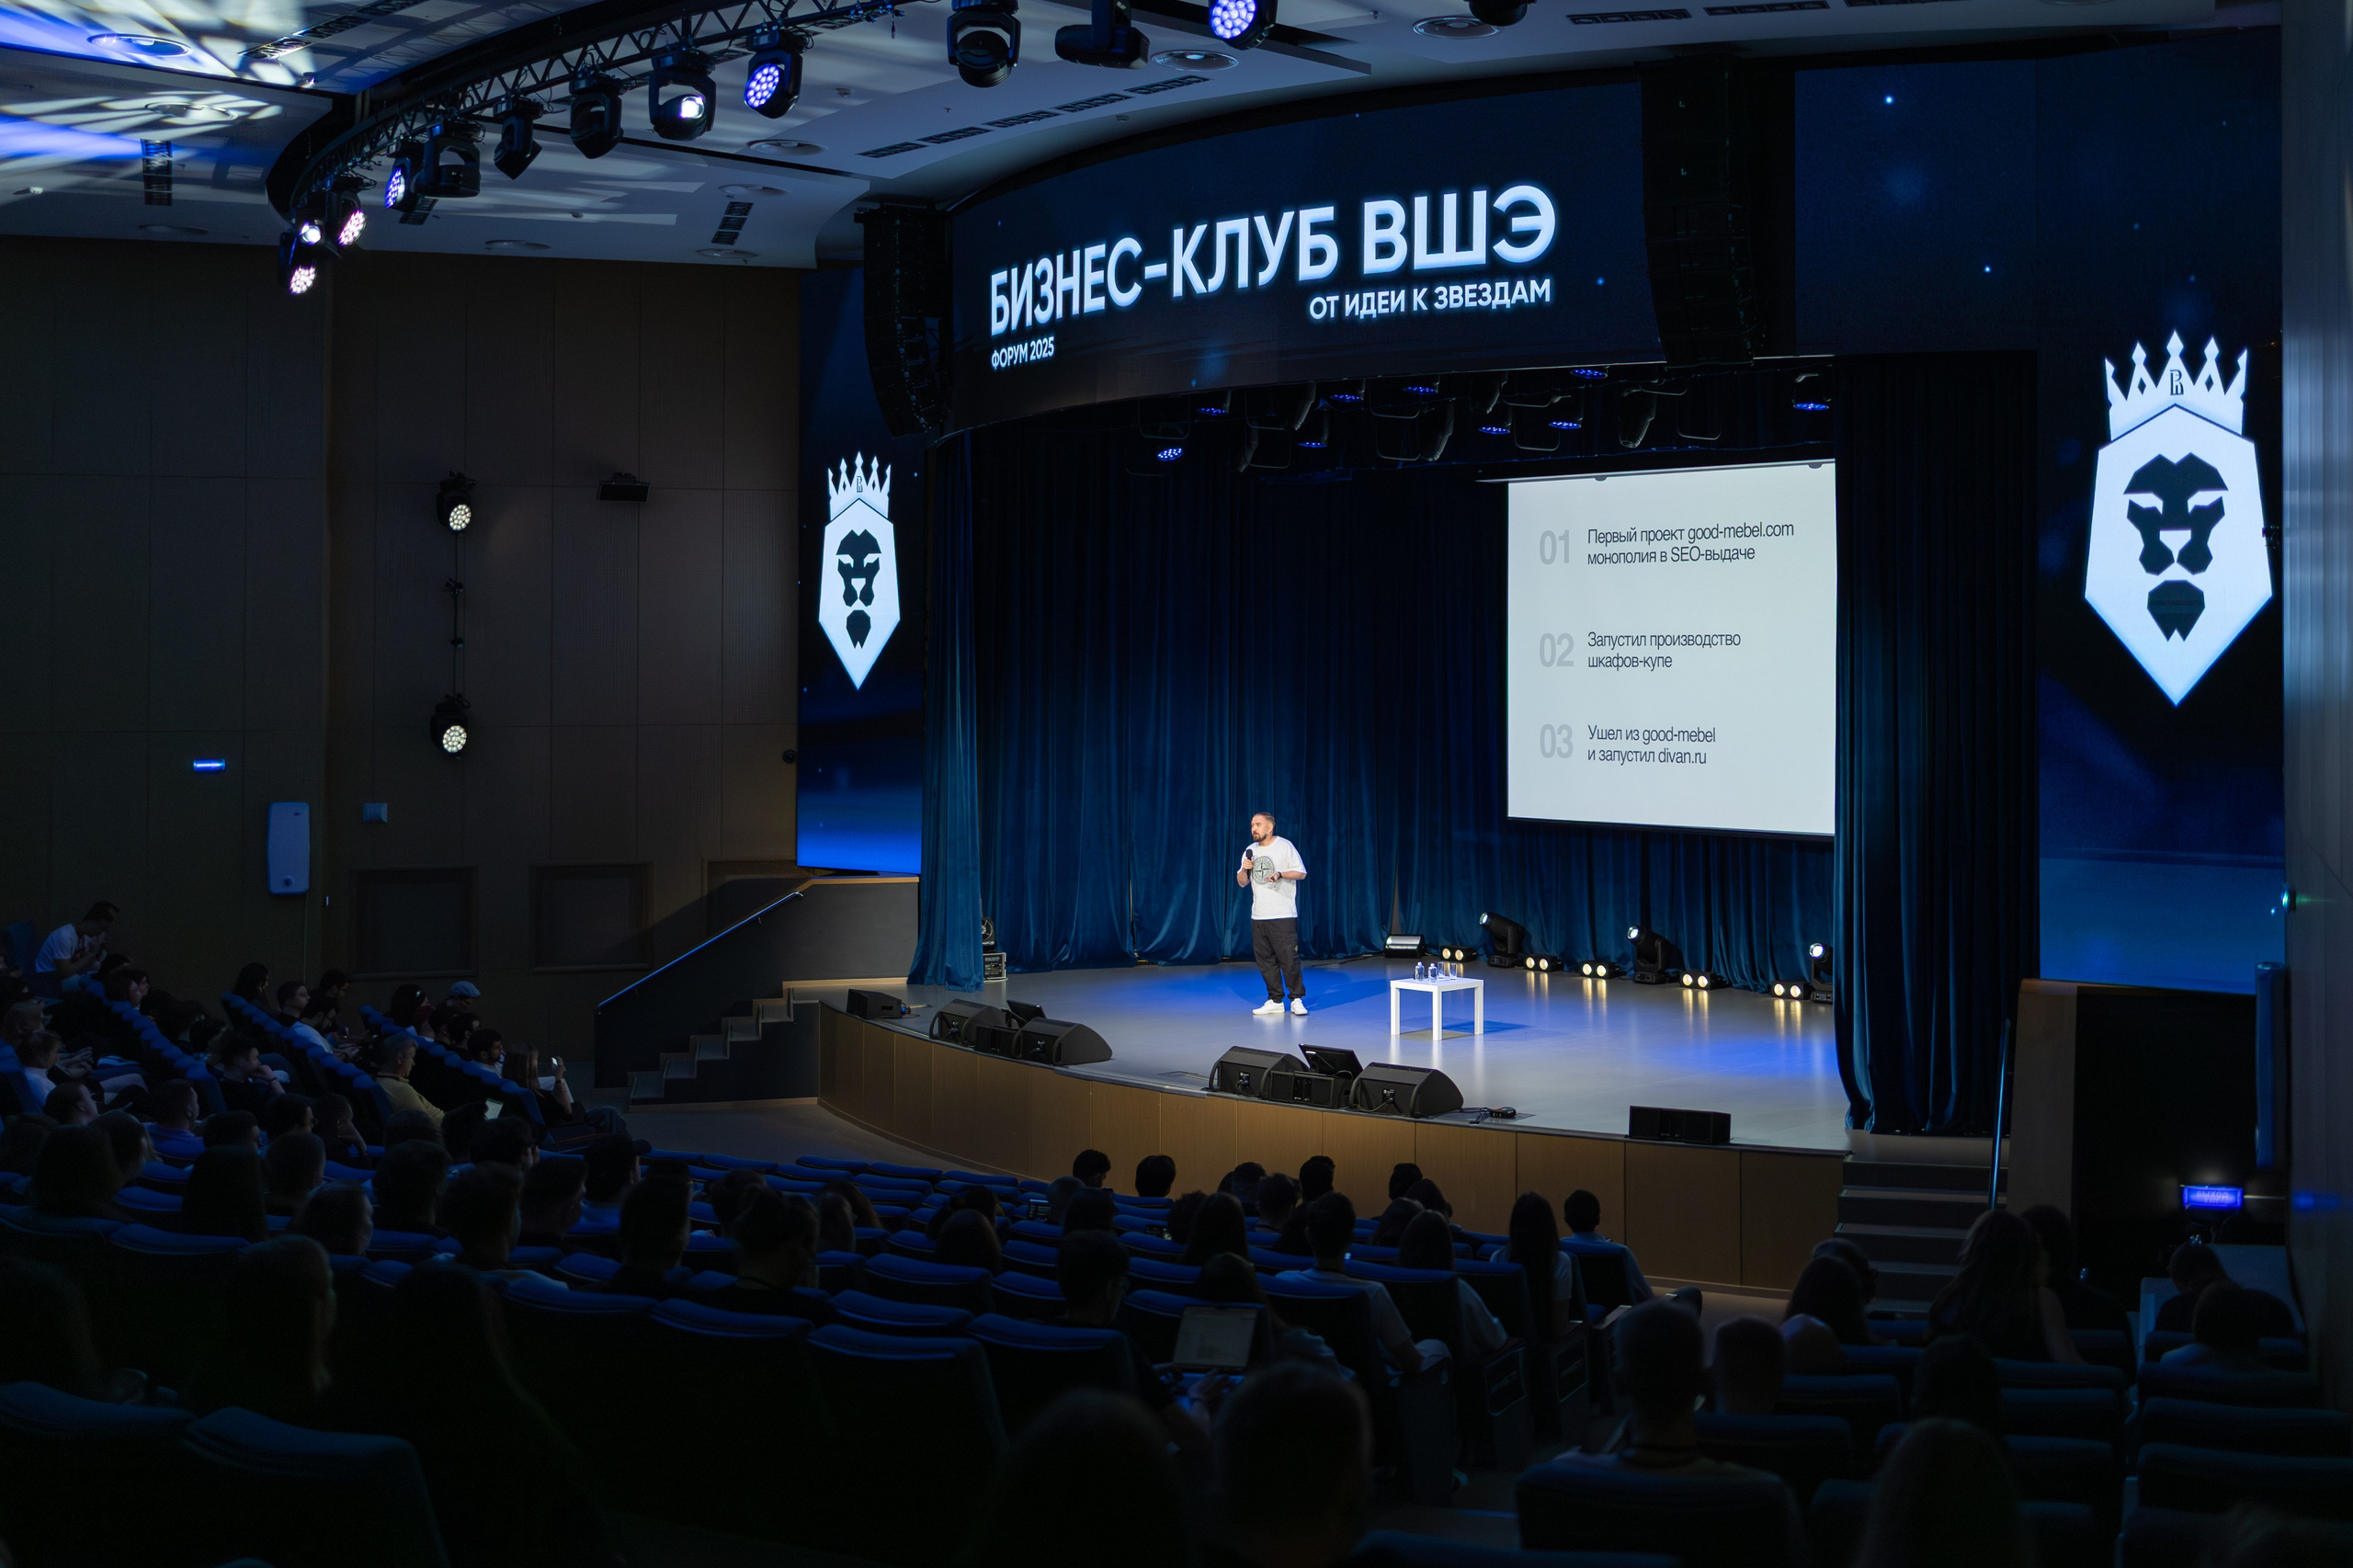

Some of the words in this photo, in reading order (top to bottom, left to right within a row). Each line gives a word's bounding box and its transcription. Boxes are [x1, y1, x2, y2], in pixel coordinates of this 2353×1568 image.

[991, 205, 1339, 336] БИЗНЕС-КЛУБ
[1363, 185, 1556, 275] ВШЭ
[1309, 295, 1339, 320] ОТ
[1345, 290, 1405, 320] ИДЕИ
[1413, 287, 1428, 312] К
[1433, 278, 1551, 311] ЗВЕЗДАМ
[991, 339, 1029, 370] ФОРУМ
[1029, 335, 1055, 361] 2025
[1539, 528, 1571, 565] 01
[1587, 527, 1637, 549] Первый
[1640, 528, 1685, 547] проект
[1688, 521, 1794, 545] good-mebel.com
[1587, 551, 1657, 565] монополия
[1659, 551, 1668, 562] в
[1670, 546, 1756, 563] SEO-выдаче
[1539, 632, 1574, 668] 02
[1587, 631, 1647, 651] Запустил
[1650, 633, 1742, 651] производство
[1587, 652, 1673, 672] шкафов-купе
[1539, 723, 1574, 759] 03
[1587, 724, 1622, 741] Ушел
[1625, 729, 1640, 741] из
[1642, 726, 1716, 745] good-mebel
[1587, 749, 1596, 761] и
[1598, 749, 1655, 767] запустил
[1657, 747, 1707, 765] divan.ru
[2196, 1190, 2229, 1199] ВЫХОД
